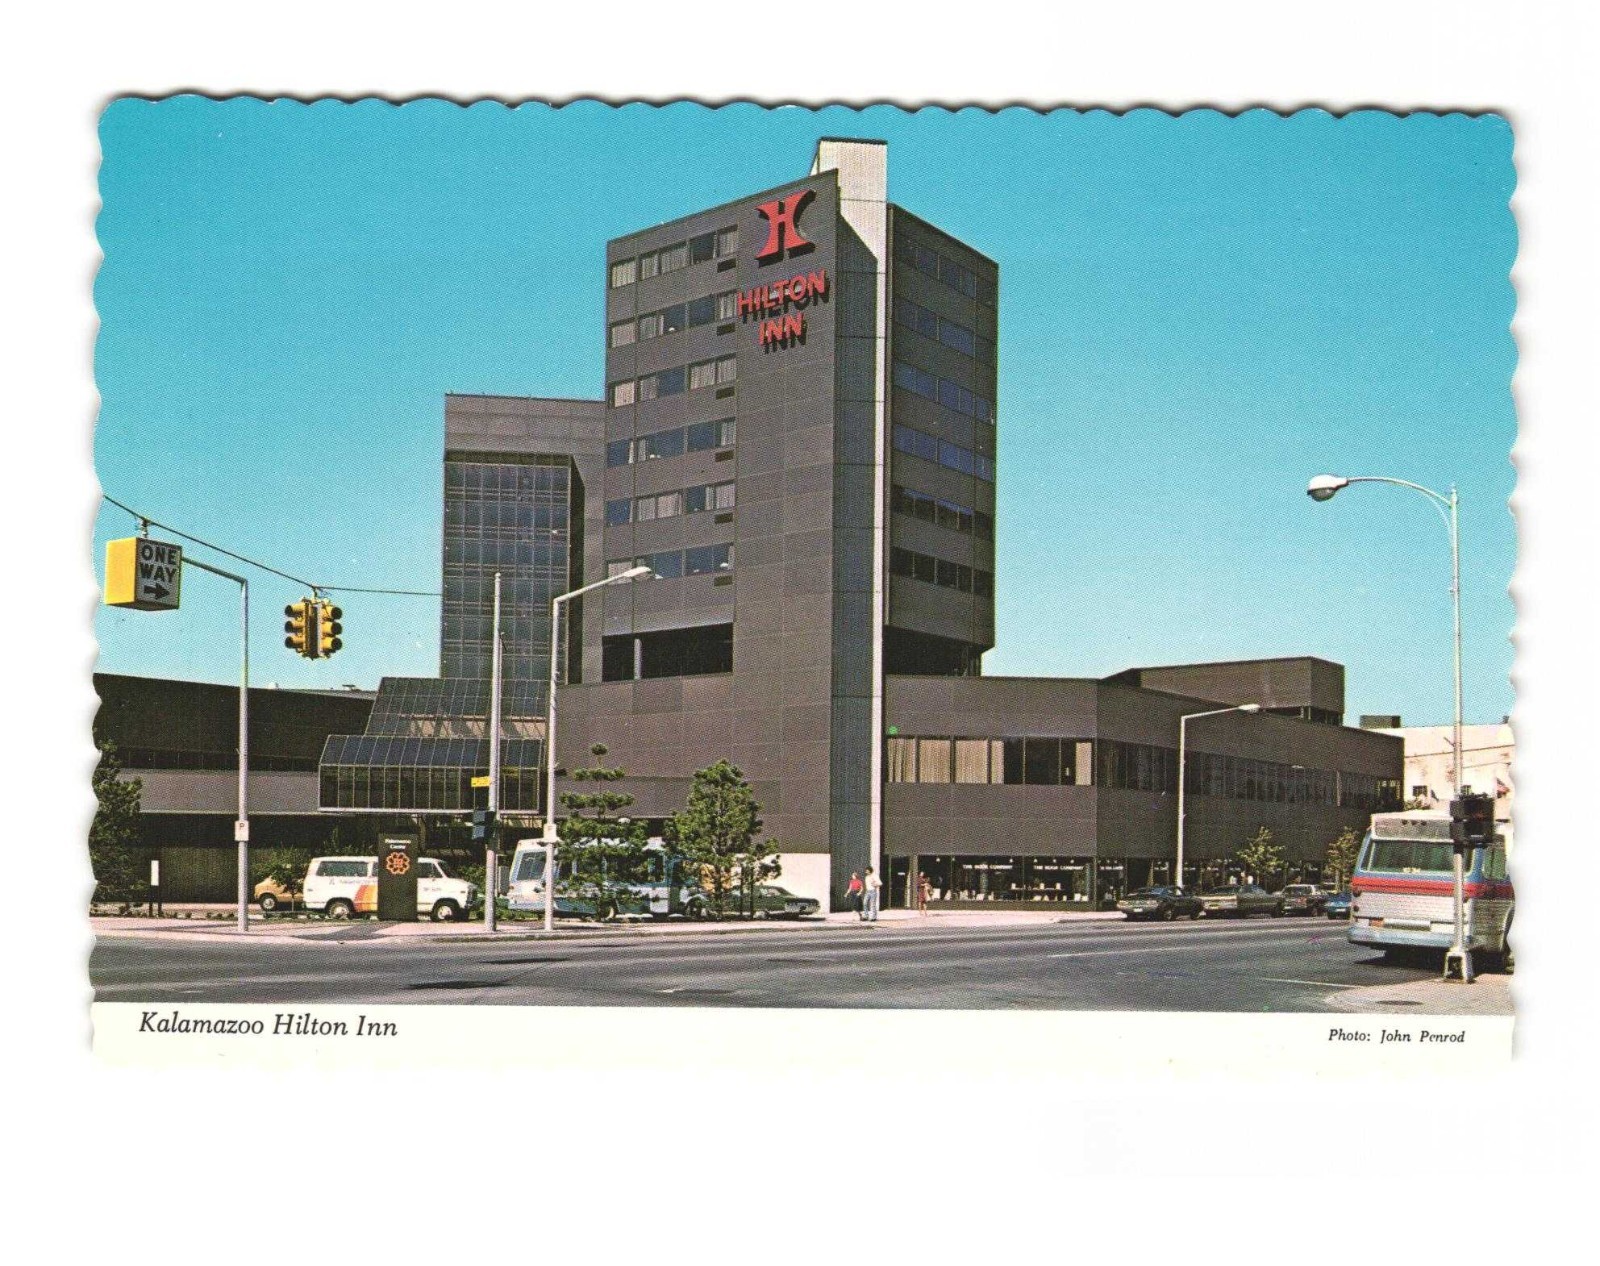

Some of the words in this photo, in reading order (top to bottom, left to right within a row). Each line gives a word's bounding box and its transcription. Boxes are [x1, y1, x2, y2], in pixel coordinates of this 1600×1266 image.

[737, 268, 826, 317] HILTON
[758, 311, 804, 346] INN
[142, 545, 177, 565] ONE
[140, 562, 177, 583] WAY
